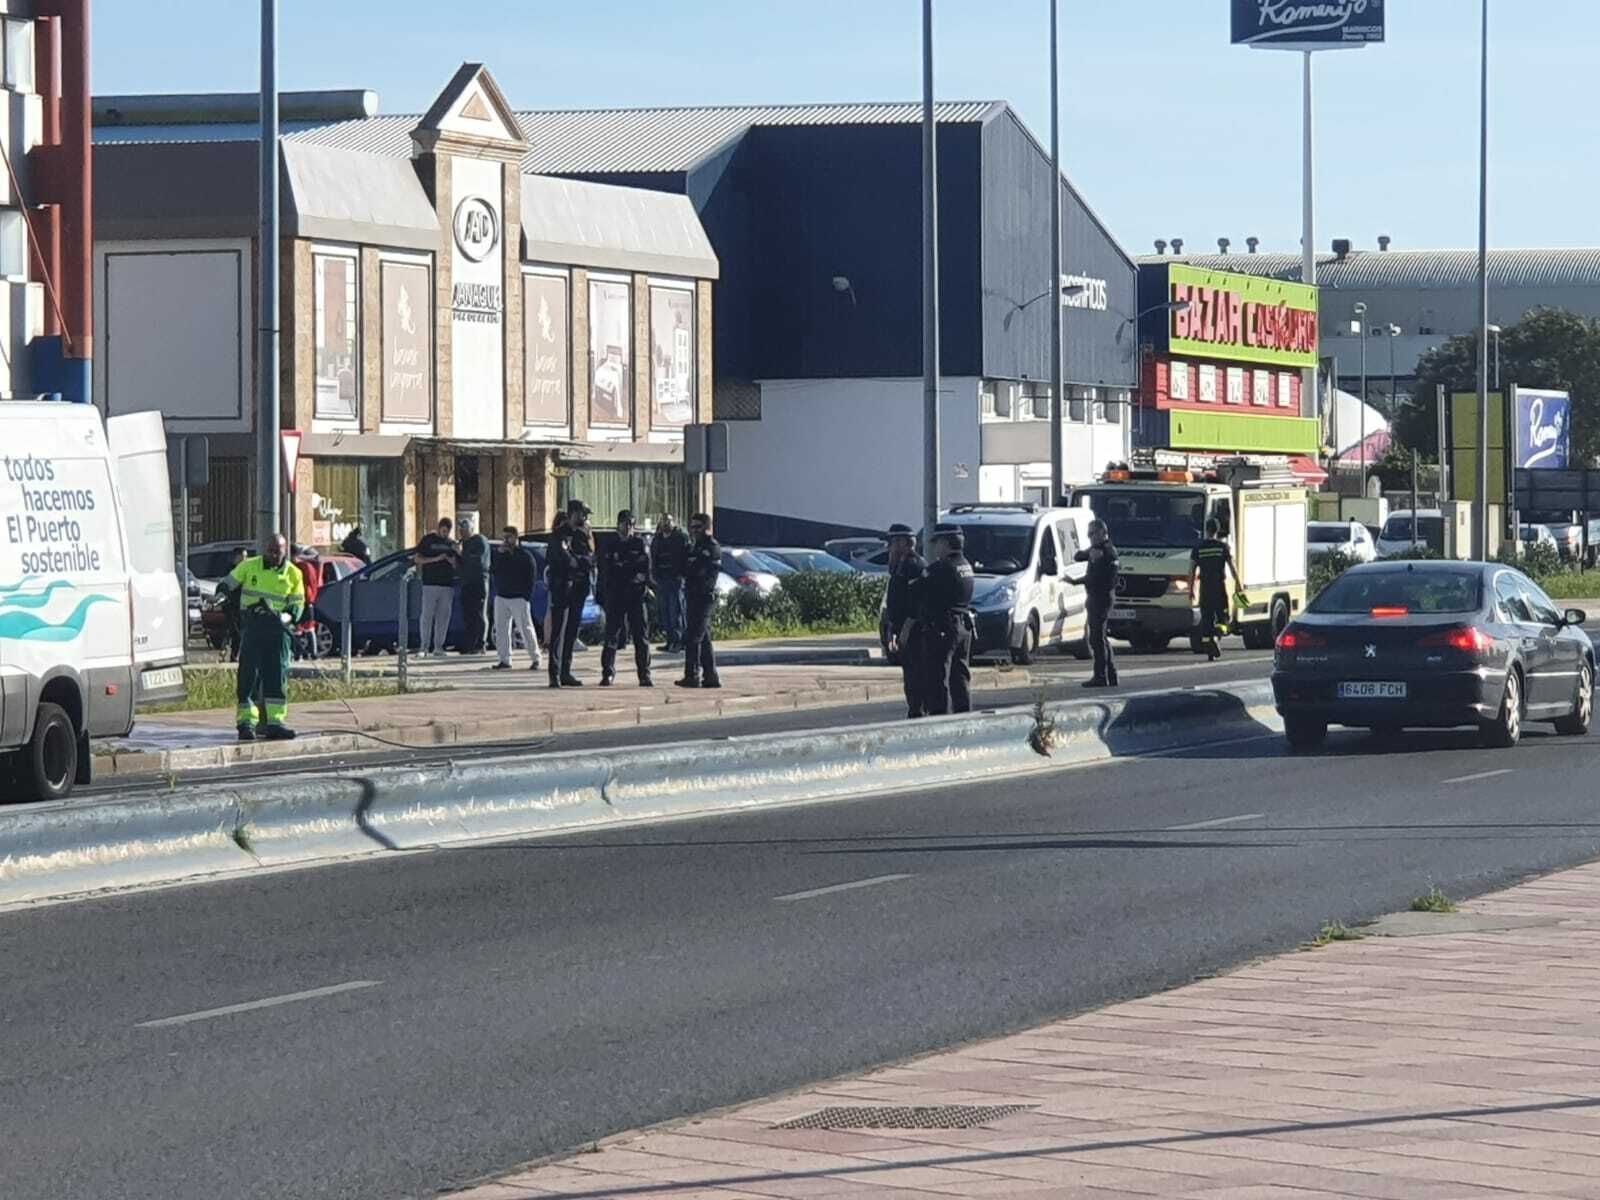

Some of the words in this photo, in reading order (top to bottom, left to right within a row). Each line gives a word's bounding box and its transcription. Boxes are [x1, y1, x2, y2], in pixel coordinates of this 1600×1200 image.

[1171, 283, 1242, 346] BAZAR
[5, 453, 55, 481] todos
[21, 484, 95, 511] hacemos
[7, 515, 22, 543] El
[27, 515, 81, 542] Puerto
[21, 543, 101, 574] sostenible
[1379, 683, 1403, 695] FCH
